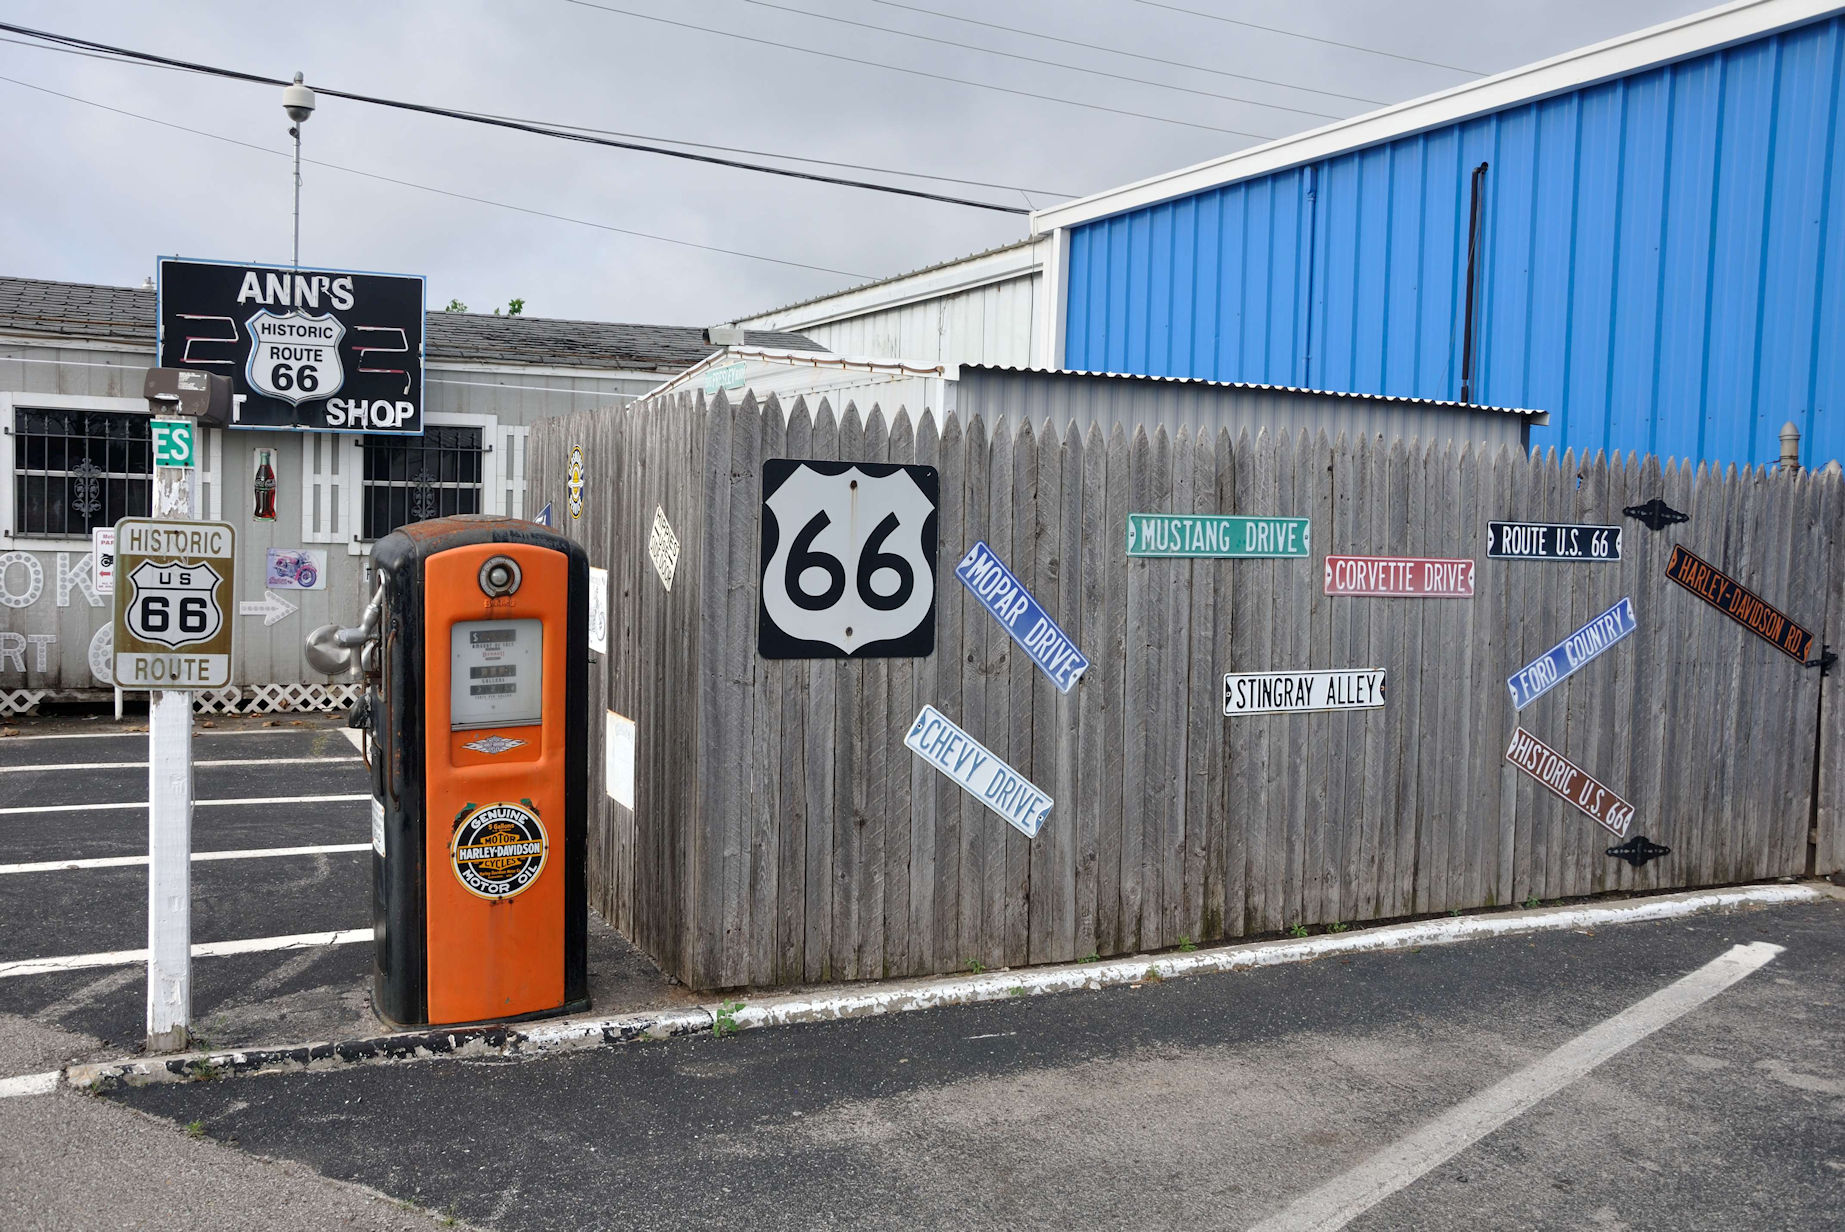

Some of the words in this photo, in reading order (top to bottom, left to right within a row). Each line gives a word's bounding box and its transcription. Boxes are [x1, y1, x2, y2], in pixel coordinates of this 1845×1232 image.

[236, 271, 355, 311] ANN'S
[261, 323, 333, 340] HISTORIC
[270, 346, 323, 362] ROUTE
[271, 363, 319, 393] 66
[326, 399, 415, 428] SHOP
[154, 427, 190, 461] ES
[130, 529, 222, 555] HISTORIC
[1141, 519, 1230, 552] MUSTANG
[1245, 521, 1298, 553] DRIVE
[1502, 525, 1547, 555] ROUTE
[1556, 527, 1582, 556] U.S.
[1591, 529, 1609, 557] 66
[785, 509, 914, 611] 66
[160, 572, 191, 585] US
[1335, 560, 1414, 592] CORVETTE
[1424, 562, 1467, 593] DRIVE
[141, 596, 208, 632] 66
[966, 551, 1029, 628] MOPAR
[1023, 617, 1079, 685] DRIVE
[1678, 555, 1784, 642] HARLEY-DAVIDSON
[1784, 625, 1802, 656] RD.
[135, 658, 209, 681] ROUTE
[1519, 656, 1558, 701] FORD
[1565, 606, 1626, 670] COUNTRY
[1236, 677, 1314, 710] STINGRAY
[1327, 674, 1376, 705] ALLEY
[919, 718, 987, 782] CHEVY
[984, 769, 1044, 828] DRIVE
[1516, 734, 1578, 796] HISTORIC
[1578, 778, 1602, 818] U.S.
[1605, 796, 1626, 831] 66
[471, 809, 529, 830] GENUINE
[459, 842, 541, 861] HARLEY-DAVIDSON
[485, 834, 517, 845] MOTOR
[463, 869, 511, 893] MOTOR
[518, 865, 538, 885] OIL
[484, 858, 516, 869] CYCLES
